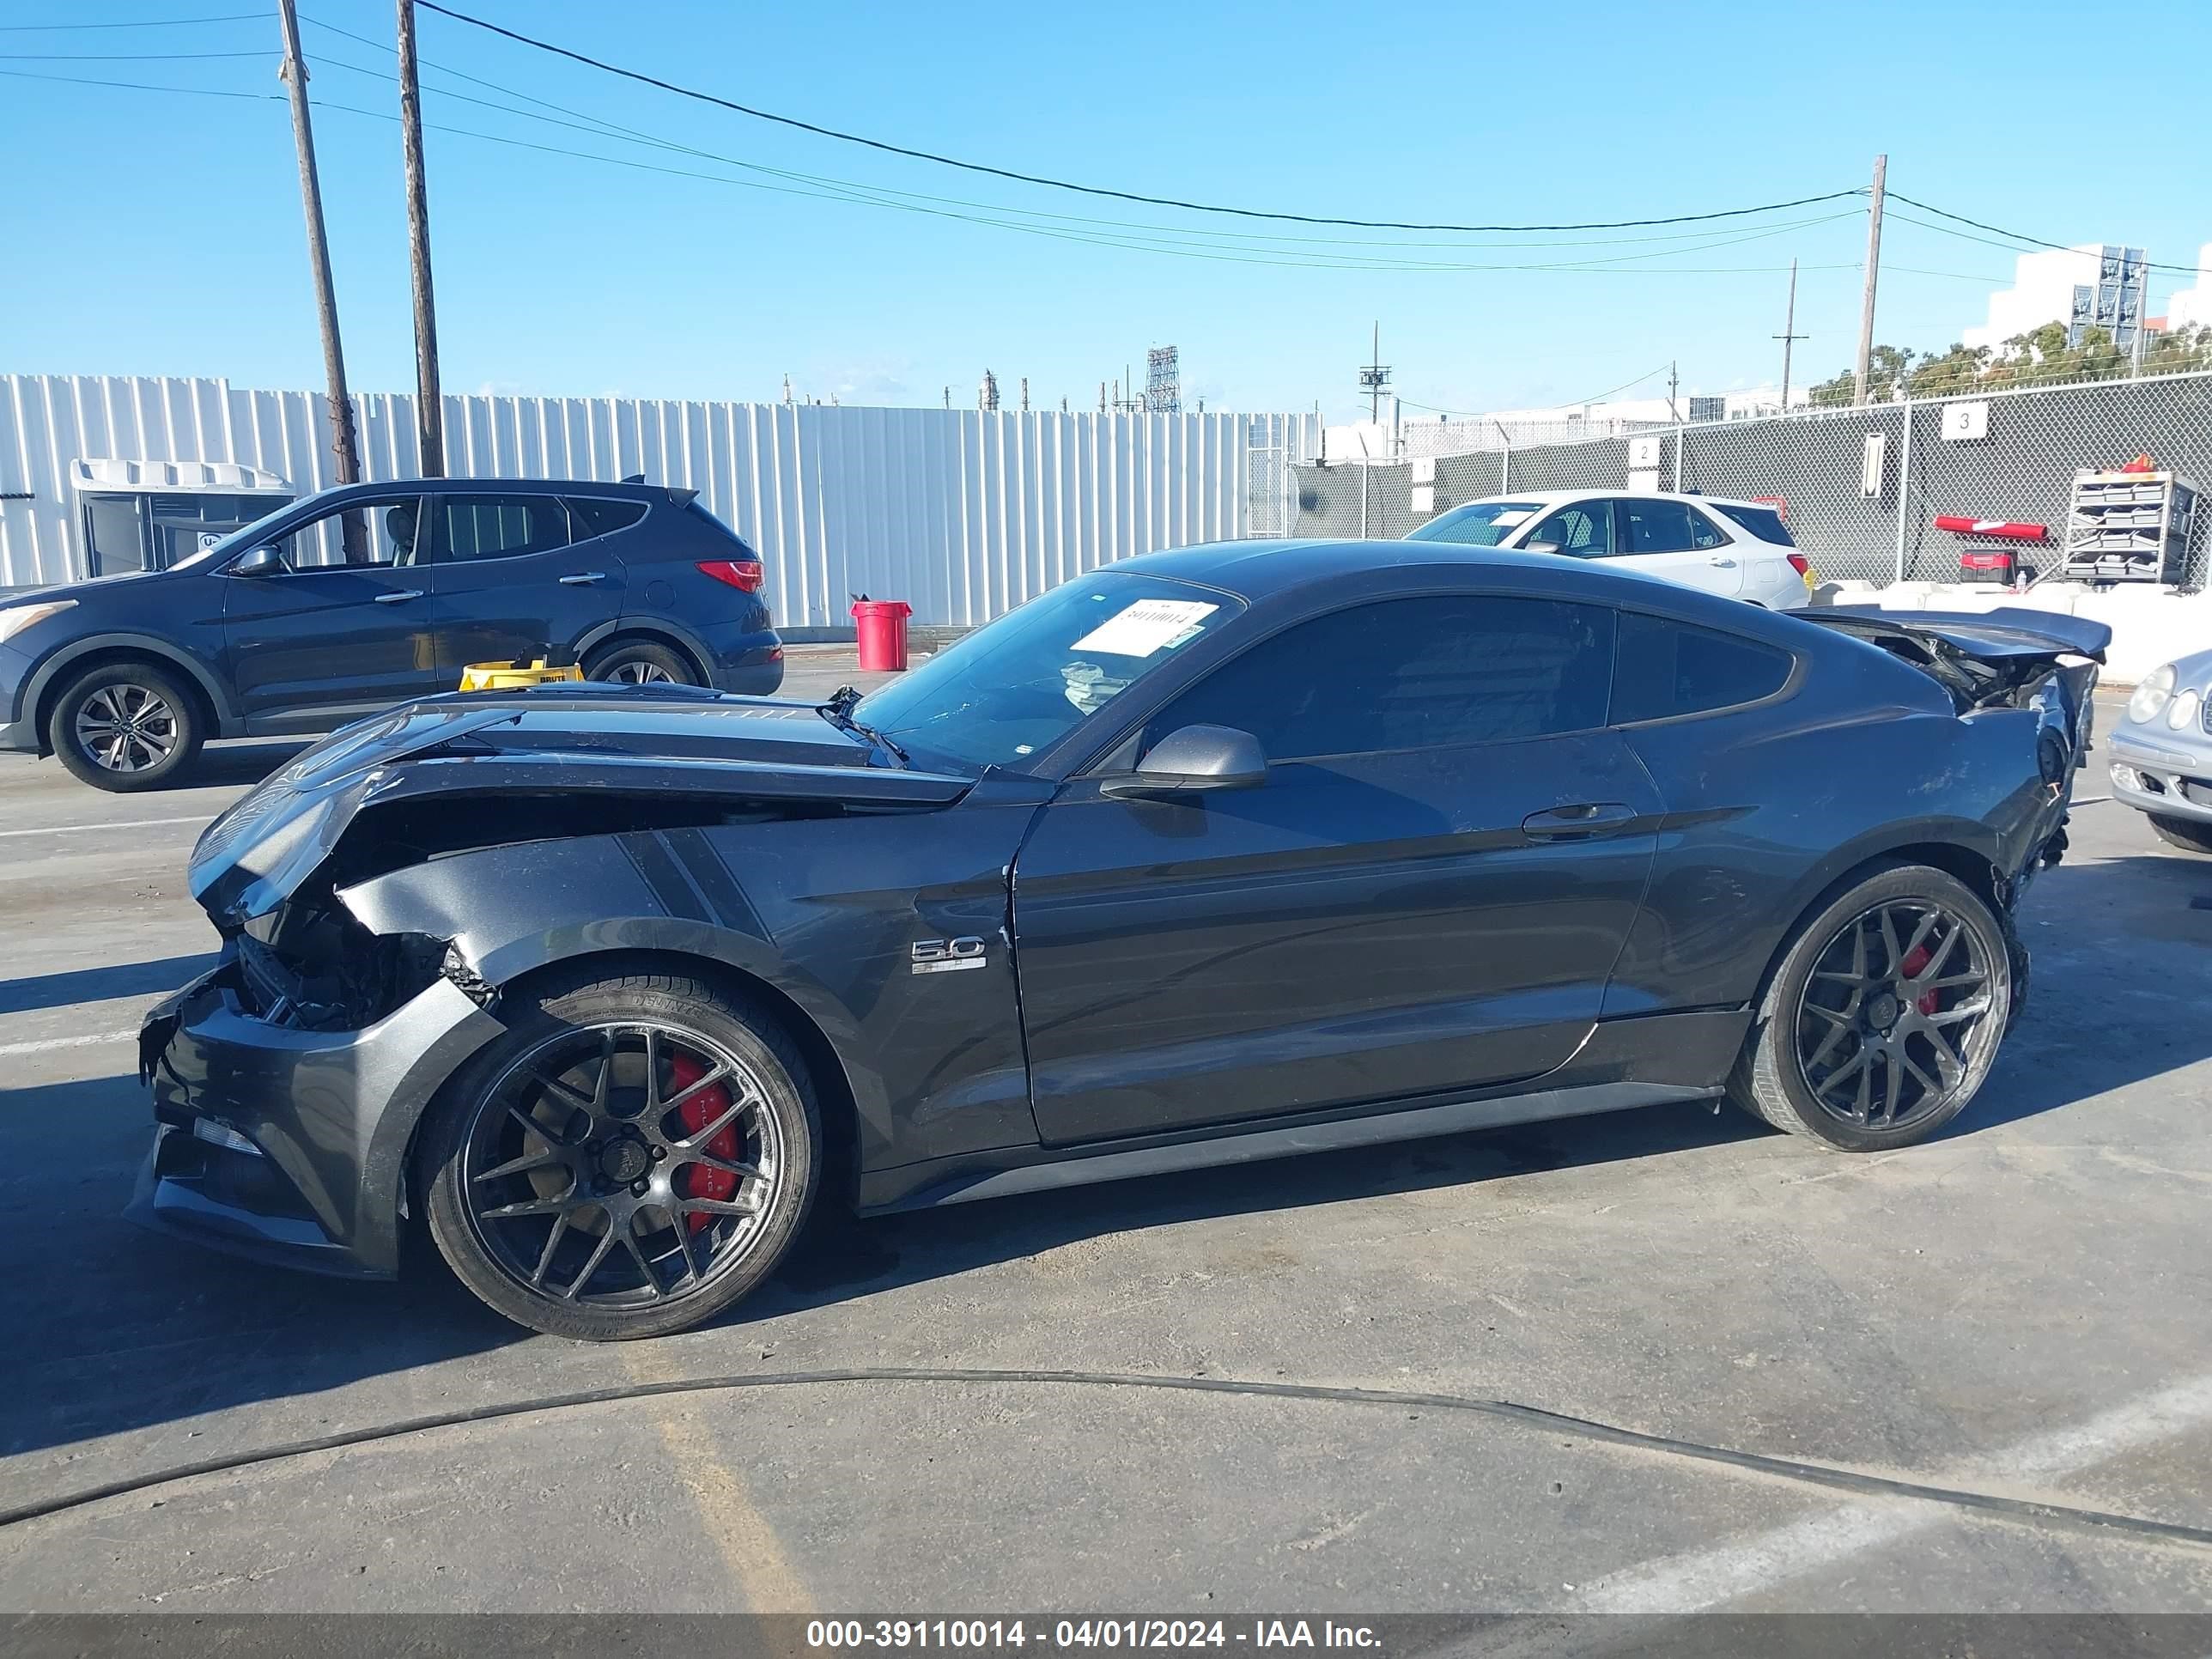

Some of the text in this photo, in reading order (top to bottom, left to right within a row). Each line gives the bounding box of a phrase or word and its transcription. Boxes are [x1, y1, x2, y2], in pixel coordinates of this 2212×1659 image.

[1960, 412, 1970, 429] 3
[1641, 446, 1648, 459] 2
[539, 675, 567, 684] BRUTE
[911, 935, 986, 962] 5.0
